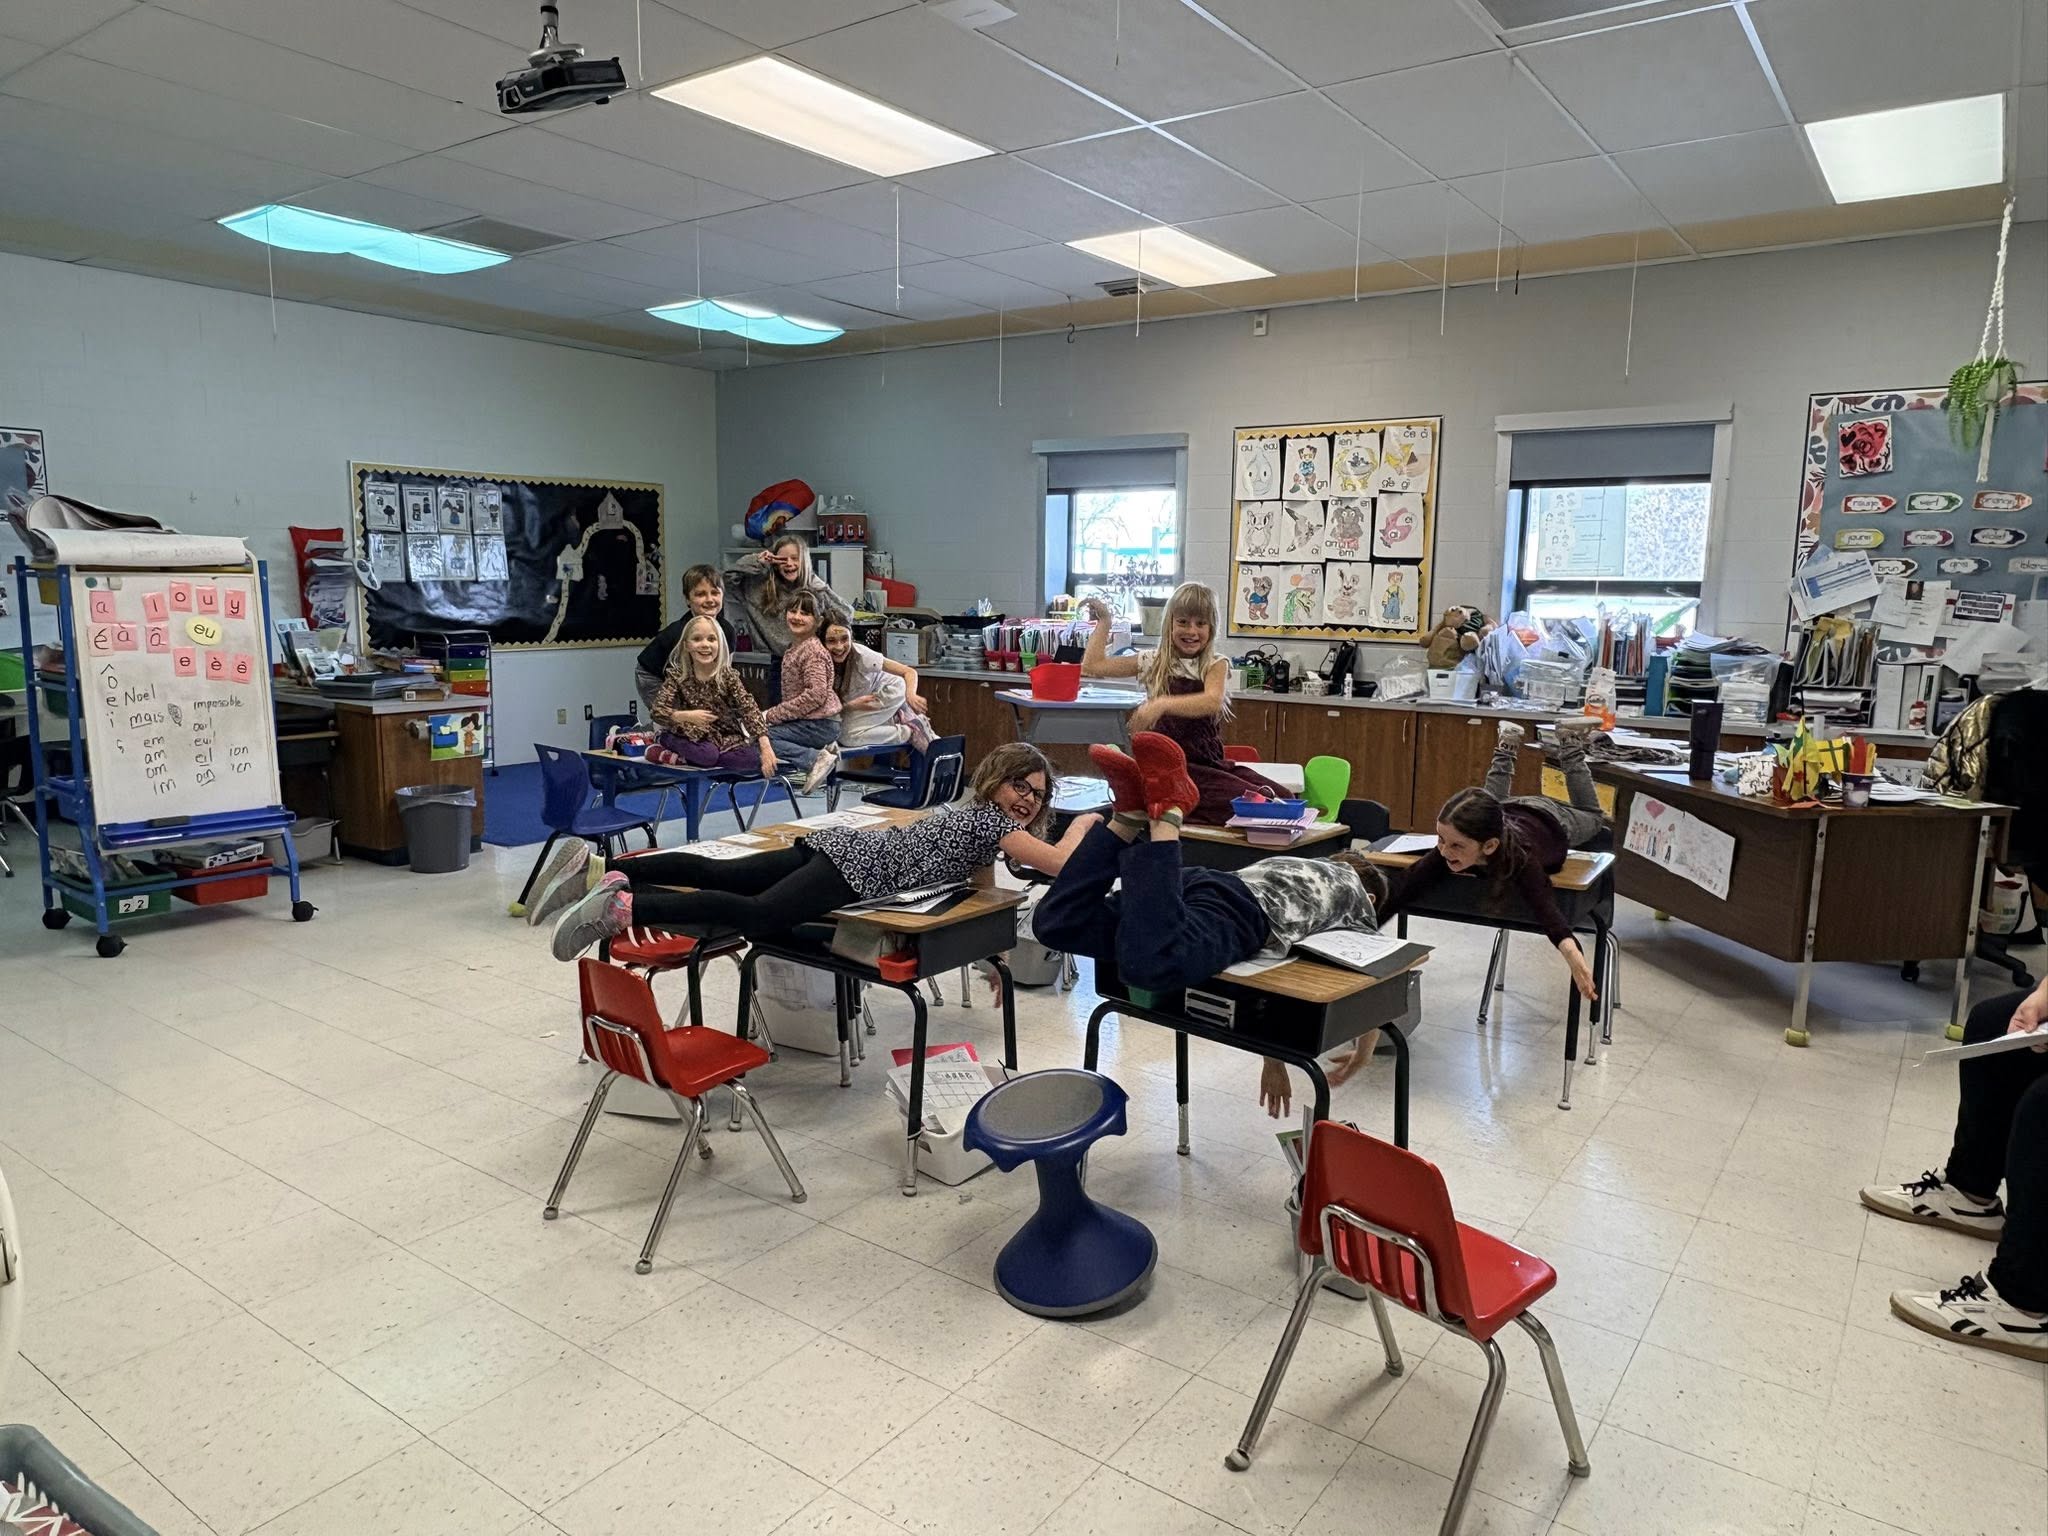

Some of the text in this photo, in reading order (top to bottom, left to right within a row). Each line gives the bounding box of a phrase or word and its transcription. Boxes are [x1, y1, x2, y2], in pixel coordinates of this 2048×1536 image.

[1316, 480, 1329, 491] gn
[1877, 562, 1900, 572] brun
[96, 601, 109, 613] a
[174, 592, 186, 602] o
[203, 594, 213, 605] u
[230, 600, 240, 614] y
[194, 624, 216, 639] eu
[94, 628, 109, 650] é
[150, 627, 167, 646] â
[180, 656, 191, 667] e
